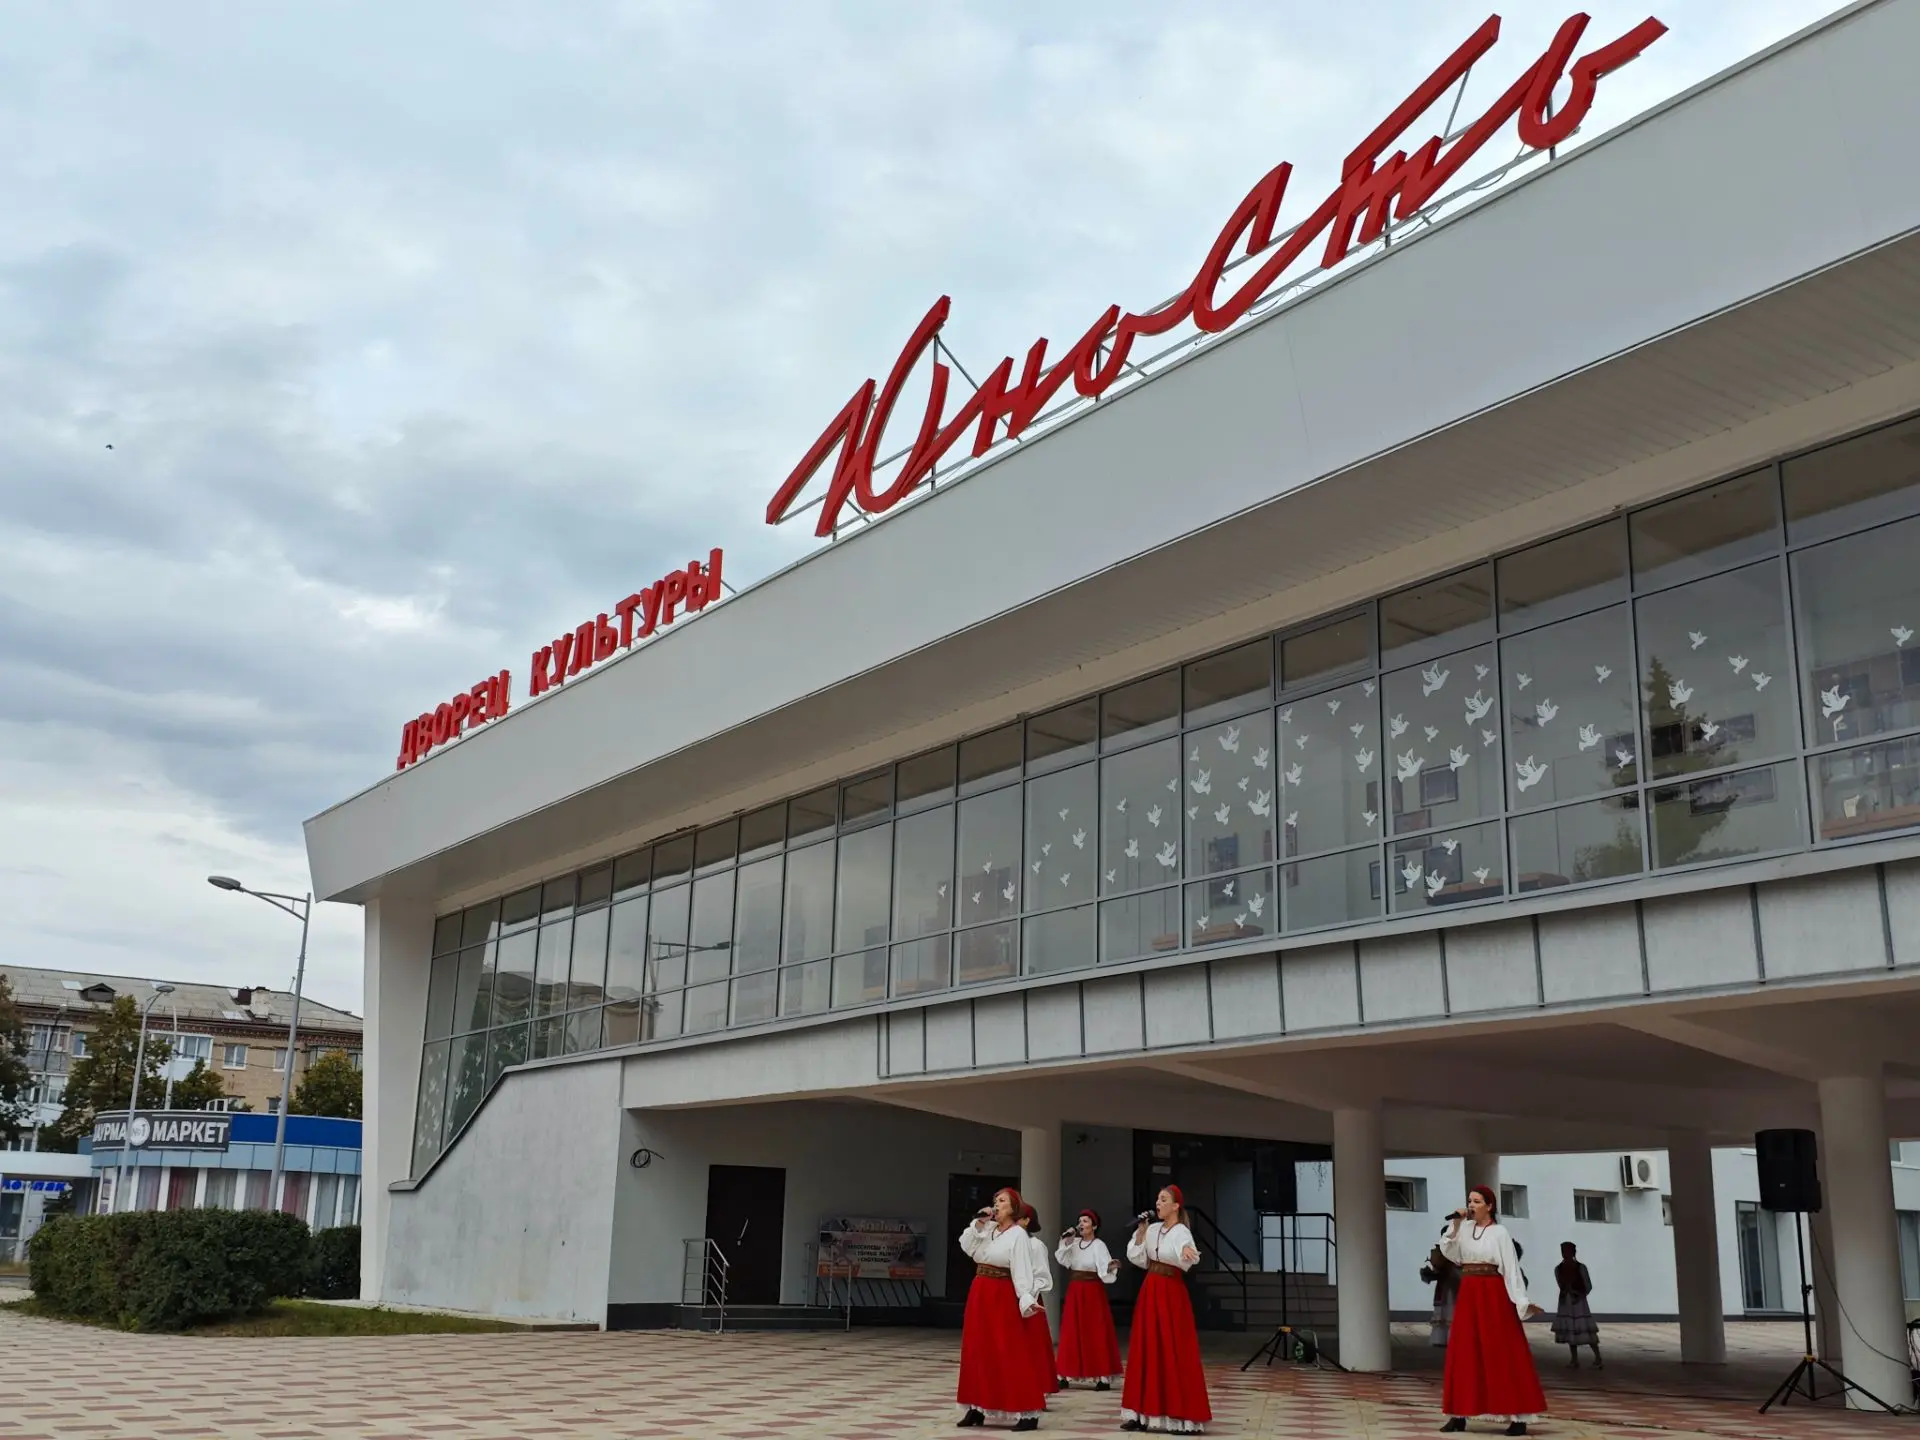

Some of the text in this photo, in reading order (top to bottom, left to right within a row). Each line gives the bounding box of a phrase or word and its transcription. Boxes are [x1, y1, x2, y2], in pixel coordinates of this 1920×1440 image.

[397, 548, 723, 770] ДВОРЕЦ КУЛЬТУРЫ
[152, 1121, 229, 1143] МАРКЕТ
